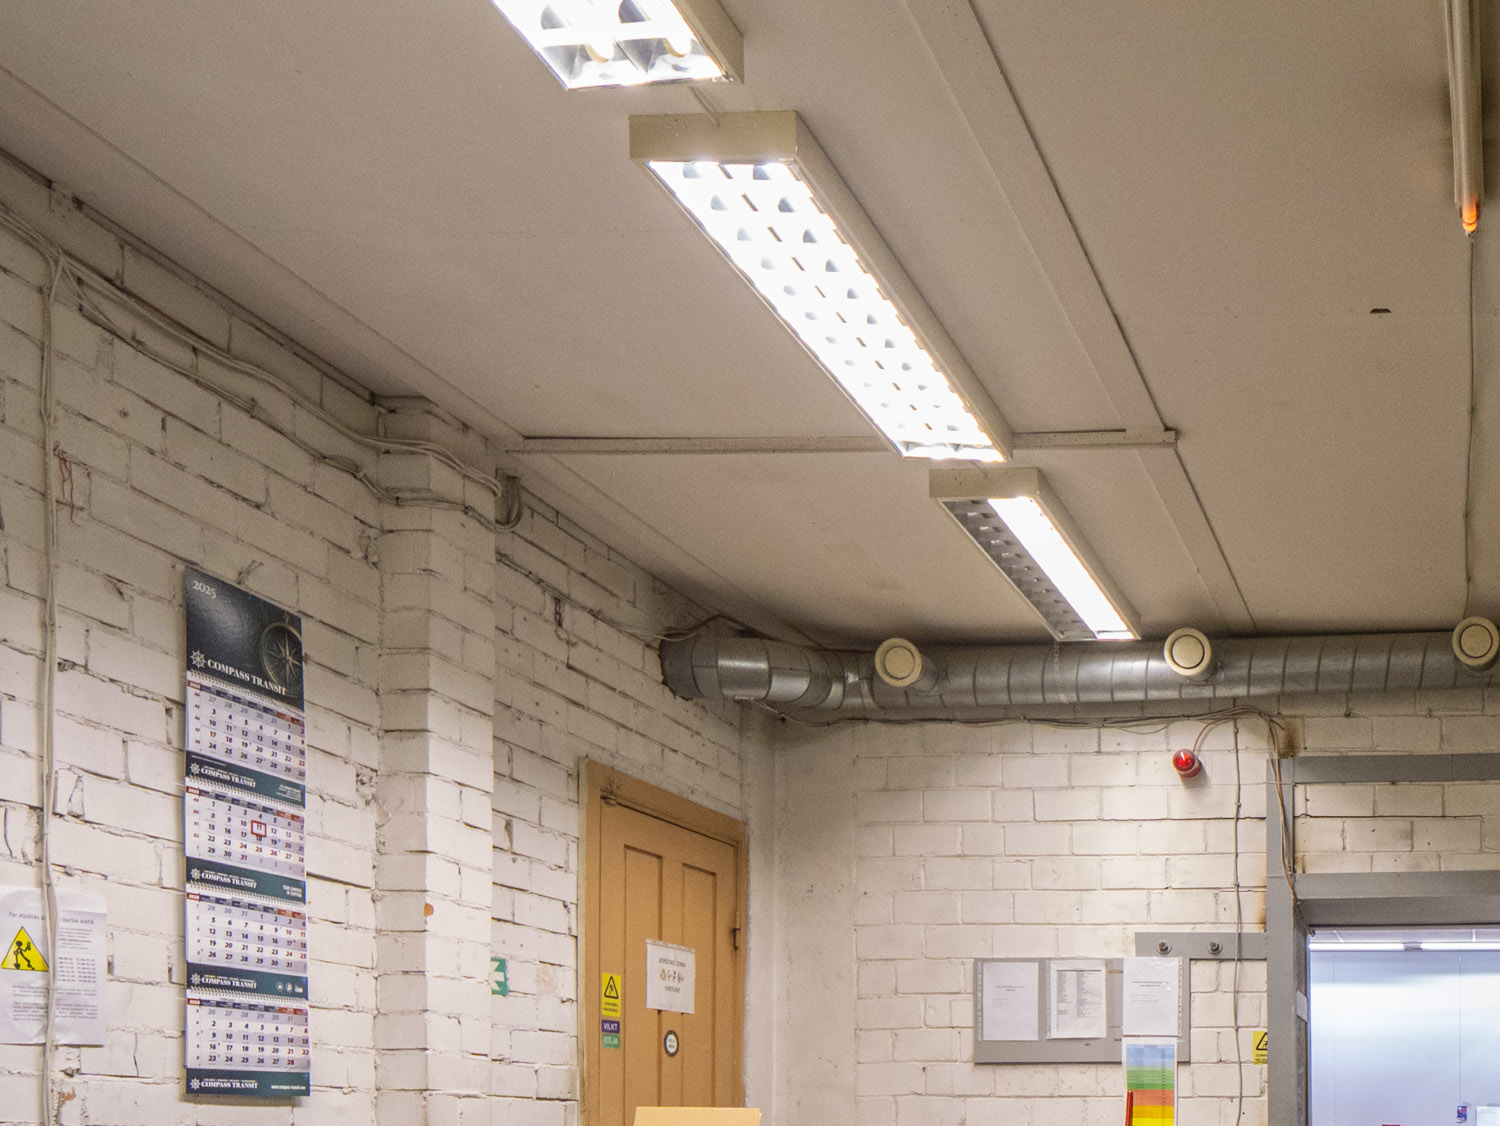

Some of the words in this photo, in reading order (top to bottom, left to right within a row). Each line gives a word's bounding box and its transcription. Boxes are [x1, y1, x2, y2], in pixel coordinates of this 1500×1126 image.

[193, 580, 216, 598] 2025
[208, 659, 250, 681] COMPASS
[251, 675, 286, 695] TRANSIT
[201, 768, 231, 782] COMPASS
[232, 776, 256, 788] TRANSIT
[202, 872, 231, 884] COMPASS
[232, 878, 257, 888] TRANSIT
[202, 978, 231, 986] COMPASS
[233, 981, 257, 989] TRANSIT
[603, 1022, 618, 1031] VILKT
